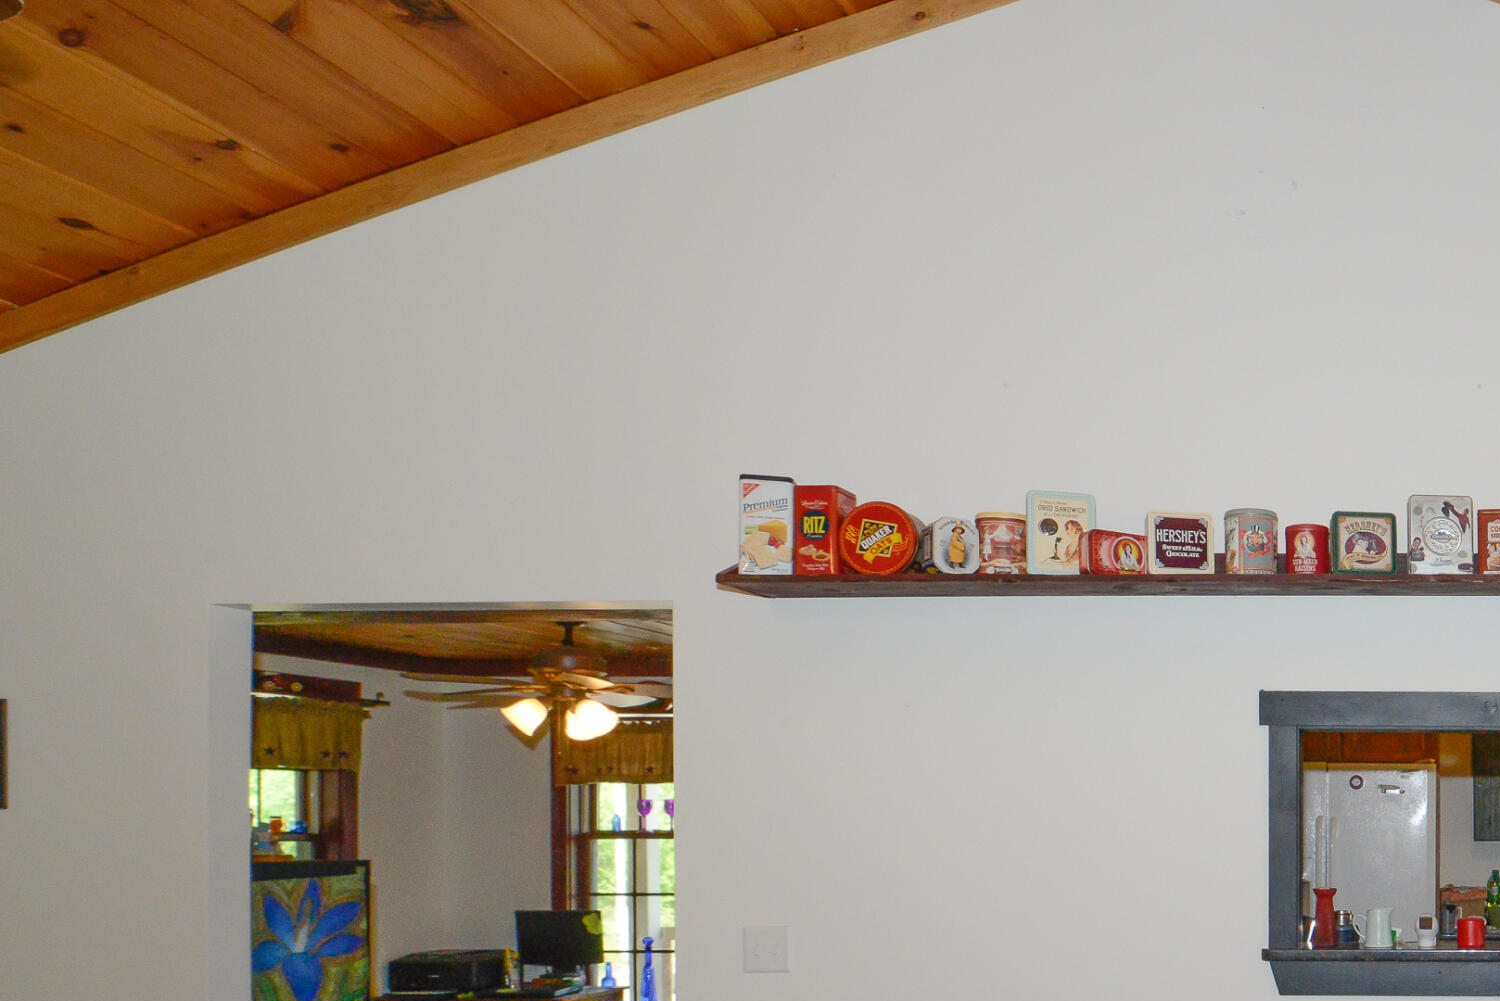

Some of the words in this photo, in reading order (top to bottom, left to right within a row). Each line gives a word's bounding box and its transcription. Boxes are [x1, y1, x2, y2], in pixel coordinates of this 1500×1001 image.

[743, 498, 788, 512] Premium
[803, 516, 826, 534] RITZ
[860, 525, 893, 550] QUAKER
[870, 536, 893, 554] OATS
[1156, 528, 1207, 544] HERSHEY'S
